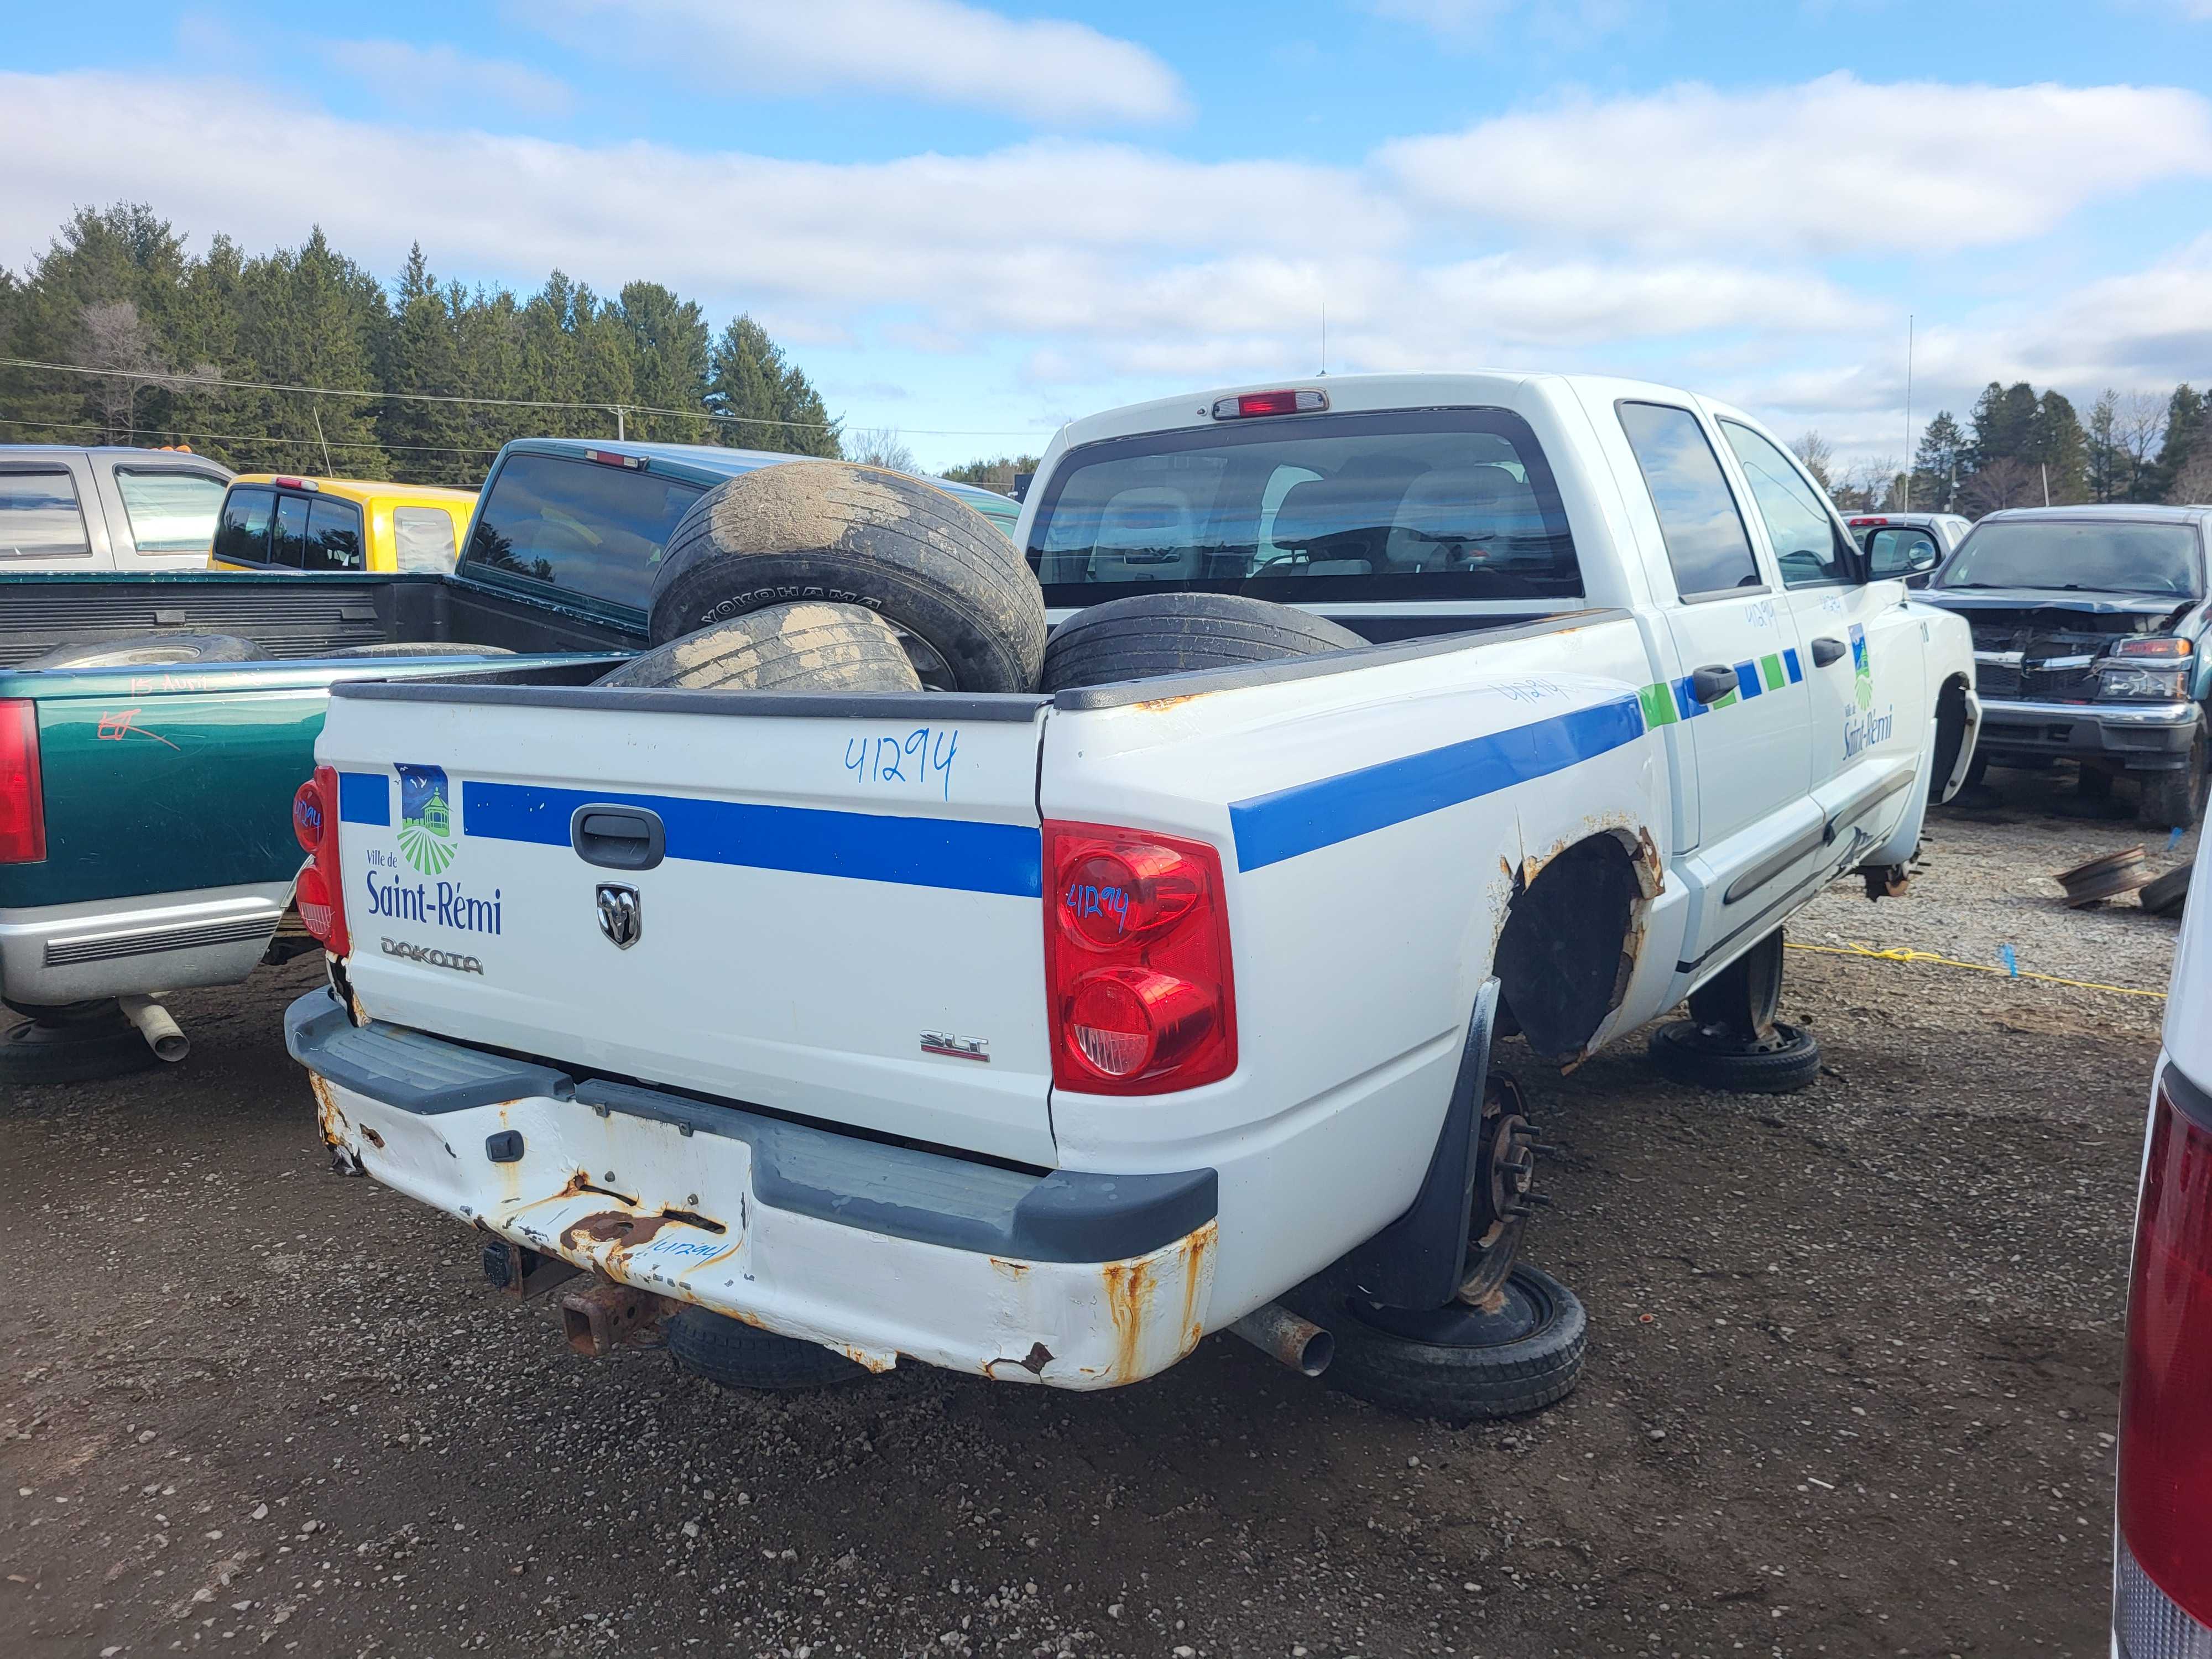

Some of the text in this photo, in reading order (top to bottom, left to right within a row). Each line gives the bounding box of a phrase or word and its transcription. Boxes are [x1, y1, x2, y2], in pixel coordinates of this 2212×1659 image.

[701, 586, 882, 624] YOKOHAMA
[1843, 703, 1893, 761] Saint-Rémi
[845, 727, 958, 802] 41294
[367, 849, 398, 868] Ville de
[367, 870, 501, 935] Saint-Rémi
[1067, 884, 1129, 935] 41294
[380, 935, 484, 976] DAKOTA
[920, 1029, 989, 1053] SLT
[653, 1241, 730, 1268] 41294
